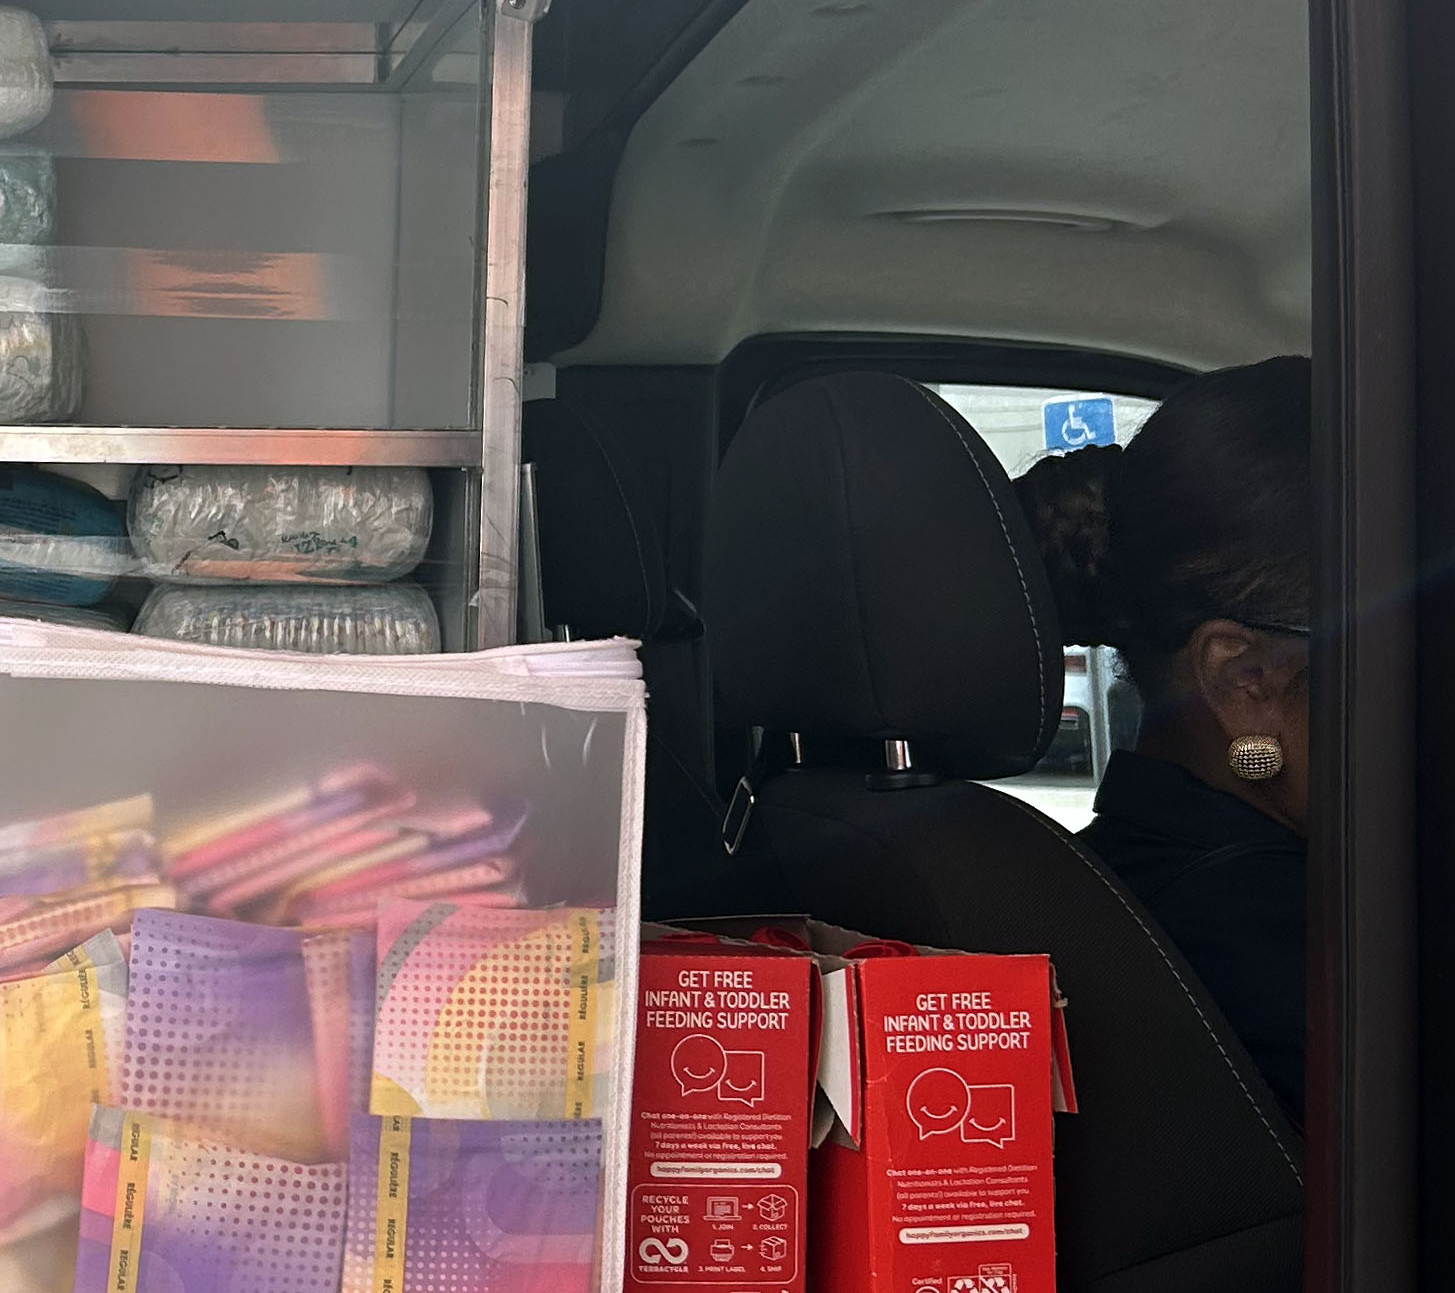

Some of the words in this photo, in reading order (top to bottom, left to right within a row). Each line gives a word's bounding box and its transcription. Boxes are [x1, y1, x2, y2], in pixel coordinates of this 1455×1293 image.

[678, 970, 709, 988] GET
[714, 971, 753, 989] FREE
[645, 991, 702, 1008] INFANT
[704, 992, 715, 1008] &
[717, 992, 790, 1009] TODDLER
[916, 994, 947, 1011] GET
[952, 992, 992, 1010] FREE
[647, 1011, 712, 1028] FEEDING
[717, 1013, 788, 1030] SUPPORT
[884, 1014, 941, 1032] INFANT
[943, 1015, 955, 1030] &
[956, 1012, 1031, 1030] TODDLER
[886, 1035, 953, 1053] FEEDING
[957, 1032, 1030, 1050] SUPPORT
[642, 1195, 688, 1204] RECYCLE
[651, 1205, 679, 1214] YOUR
[641, 1215, 690, 1224] POUCHES
[652, 1225, 679, 1233] WITH
[386, 1219, 395, 1259] REGULAR
[118, 1250, 128, 1291] REGULAR
